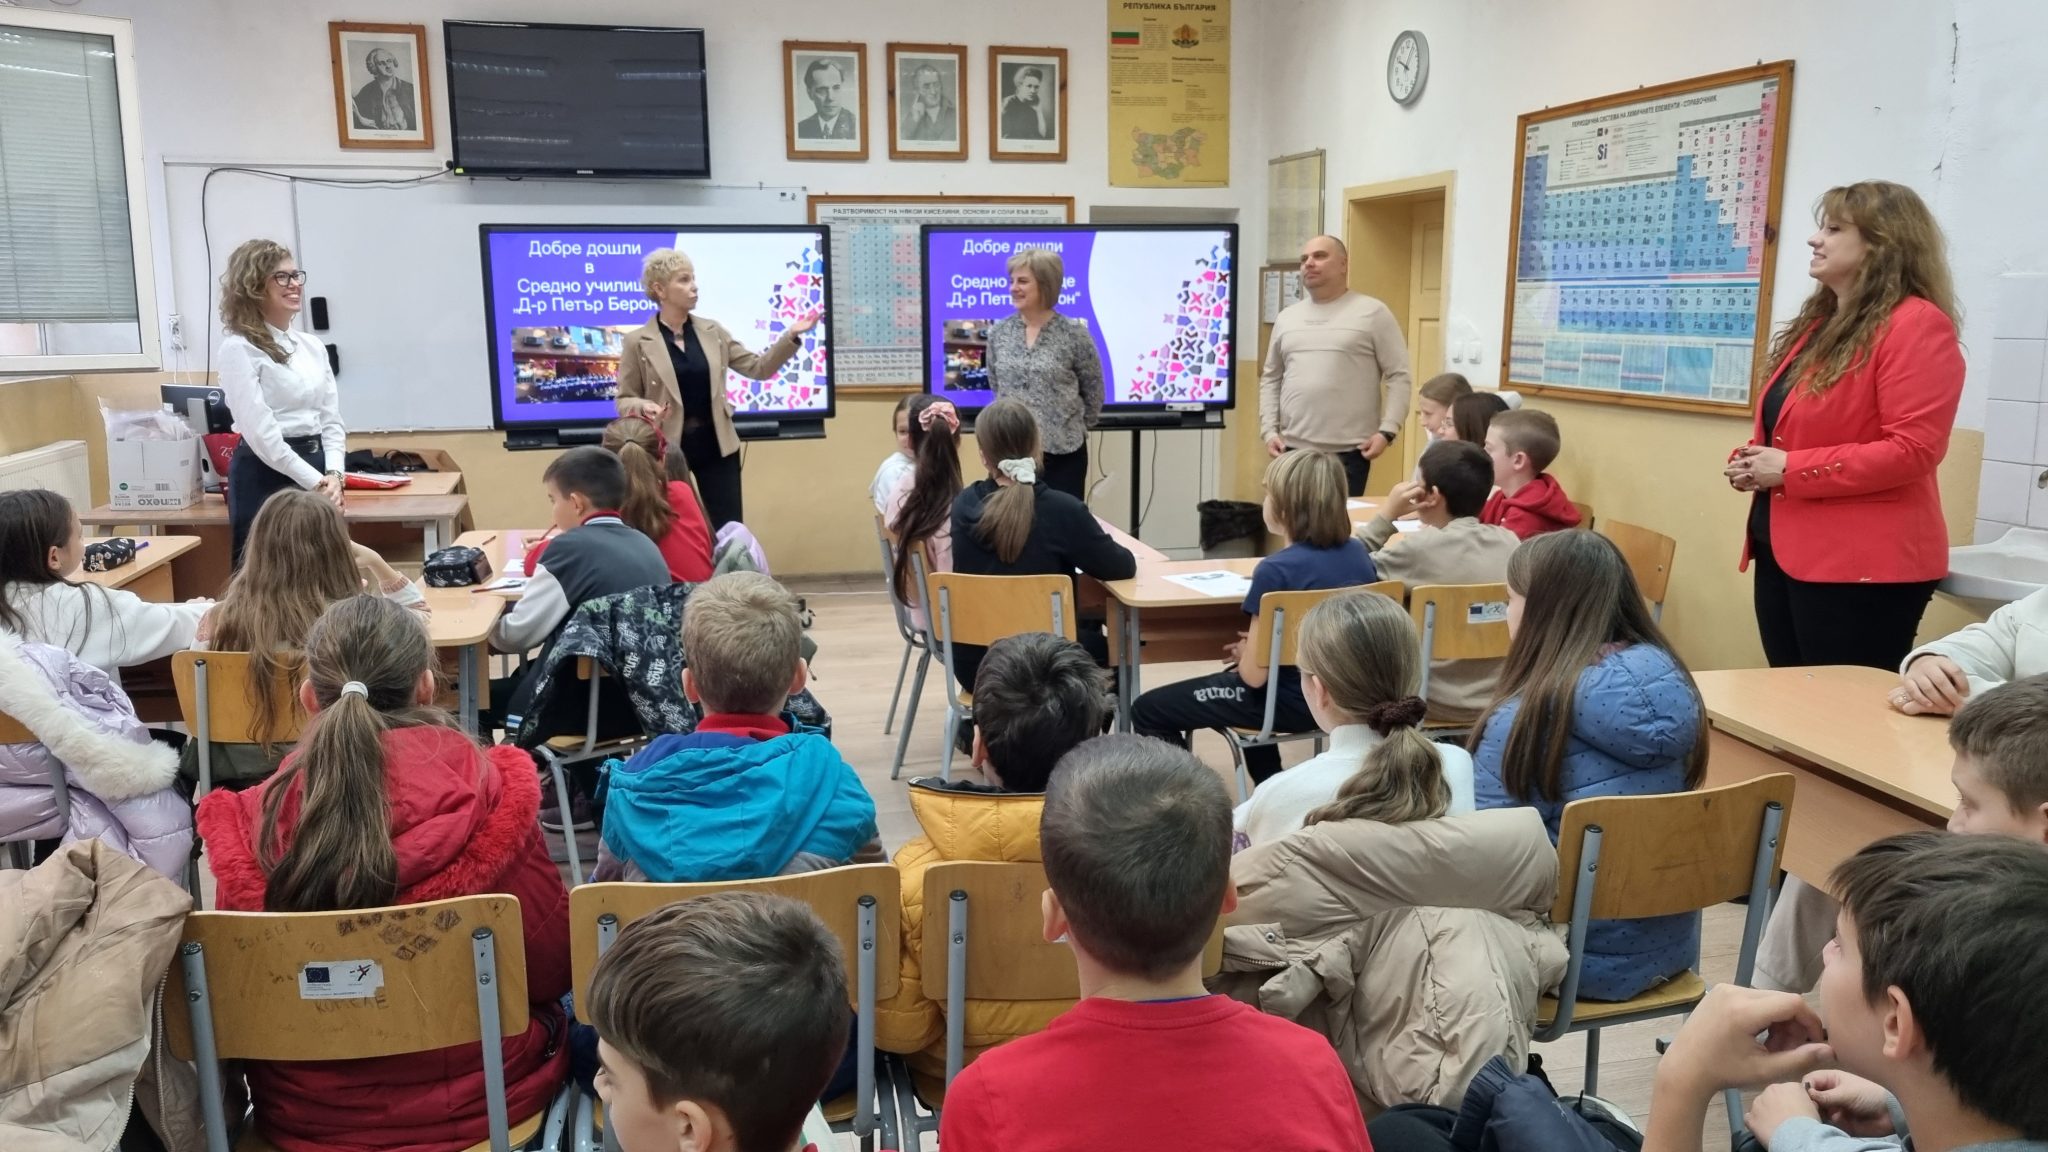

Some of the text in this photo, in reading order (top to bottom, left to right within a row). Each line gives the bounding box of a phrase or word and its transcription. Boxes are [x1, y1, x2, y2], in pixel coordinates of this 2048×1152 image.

[1122, 2, 1216, 12] РЕПУБЛИКА БЪЛГАРИЯ
[1597, 144, 1607, 161] Si
[528, 240, 642, 258] Добре дошли
[962, 240, 1010, 256] Добре
[584, 262, 594, 274] в
[517, 278, 581, 296] Средно
[951, 274, 1008, 291] Средно
[552, 297, 604, 314] Петър
[1194, 686, 1246, 702] Joma
